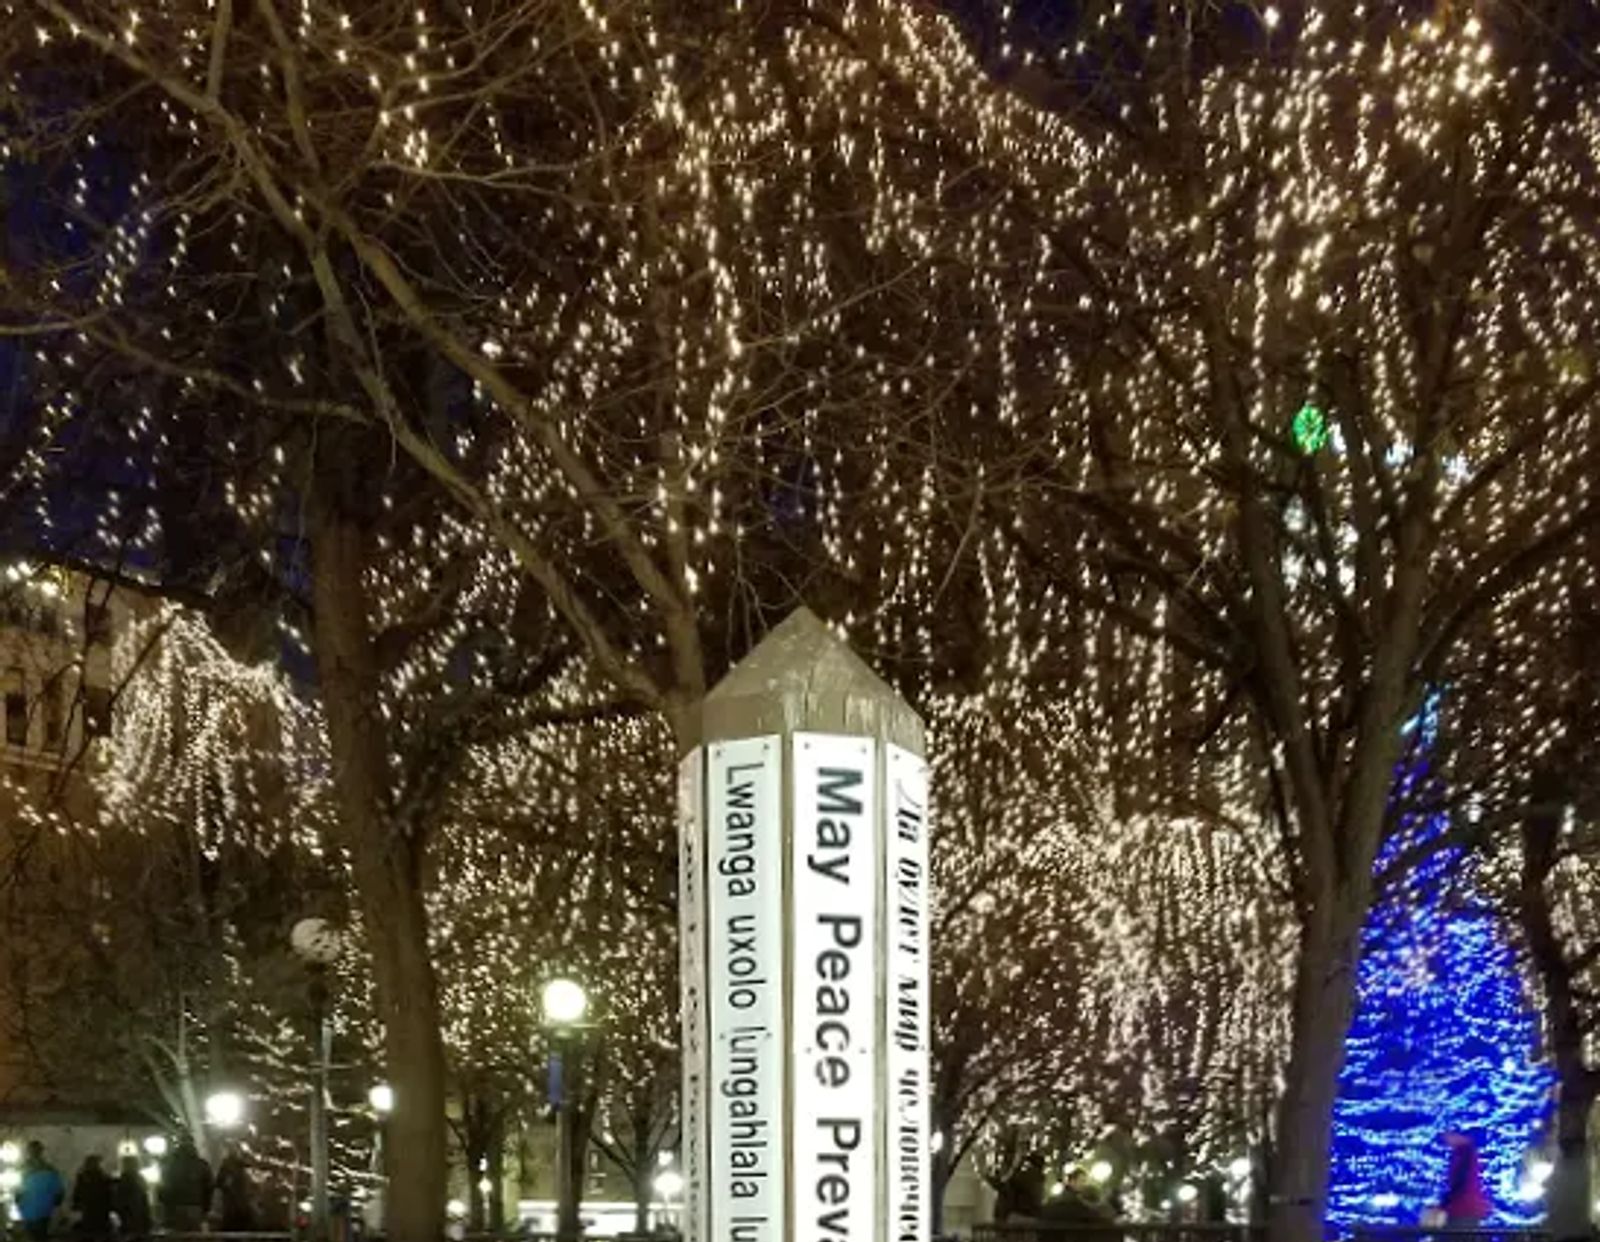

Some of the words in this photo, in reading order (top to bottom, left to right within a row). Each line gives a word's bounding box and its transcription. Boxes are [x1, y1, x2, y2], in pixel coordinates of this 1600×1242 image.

[717, 763, 764, 897] Lwanga
[807, 767, 863, 885] May
[727, 914, 767, 1009] uxolo
[816, 914, 862, 1088] Peace
[893, 976, 919, 1052] мир
[721, 1026, 768, 1198] lungahlala
